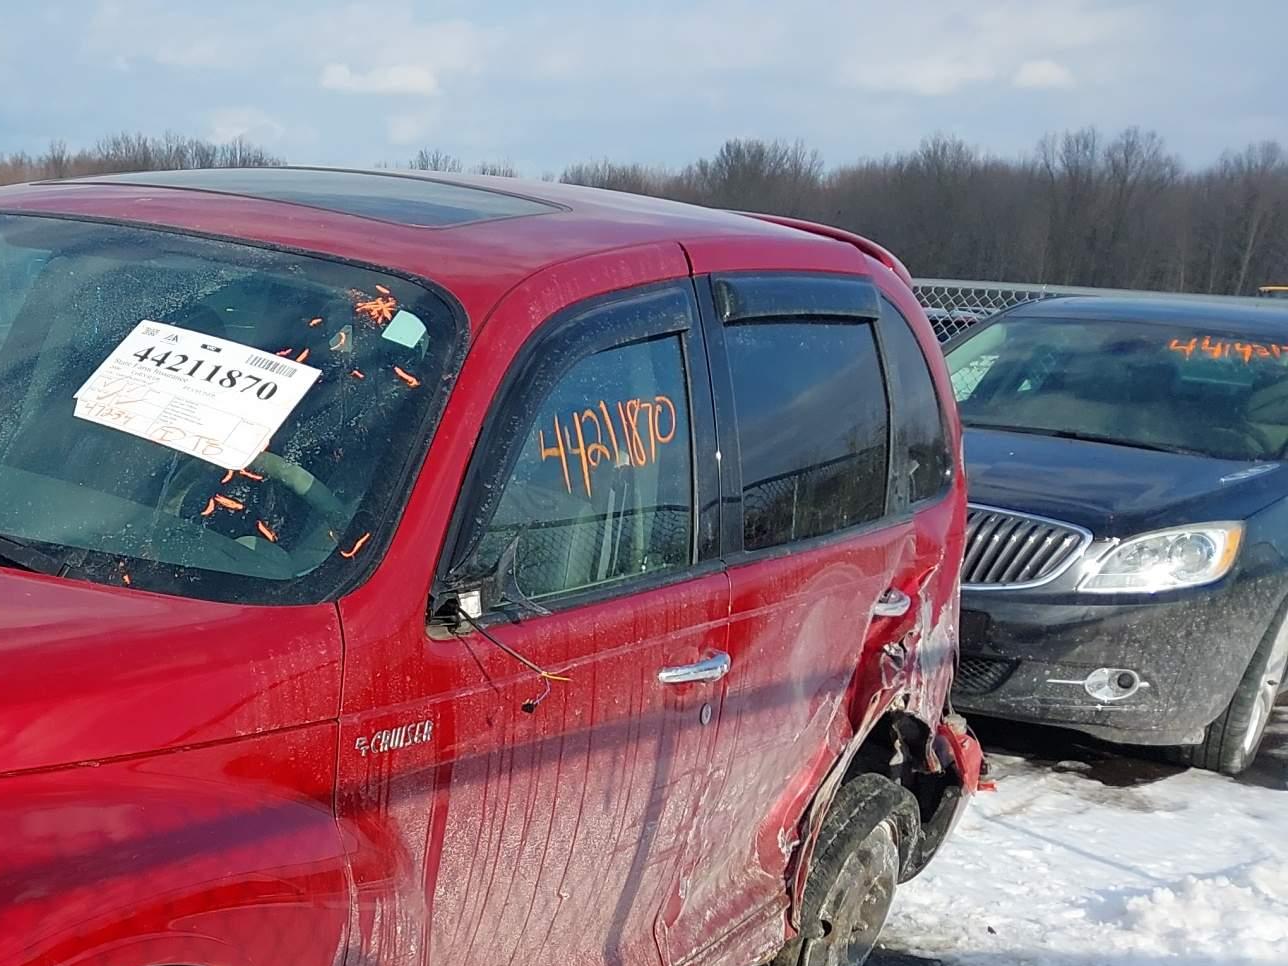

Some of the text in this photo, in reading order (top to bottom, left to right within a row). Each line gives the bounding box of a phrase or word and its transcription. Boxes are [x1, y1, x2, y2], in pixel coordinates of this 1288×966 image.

[132, 345, 279, 401] 44211870
[538, 395, 677, 499] 44211870
[370, 719, 434, 754] CRUISER
